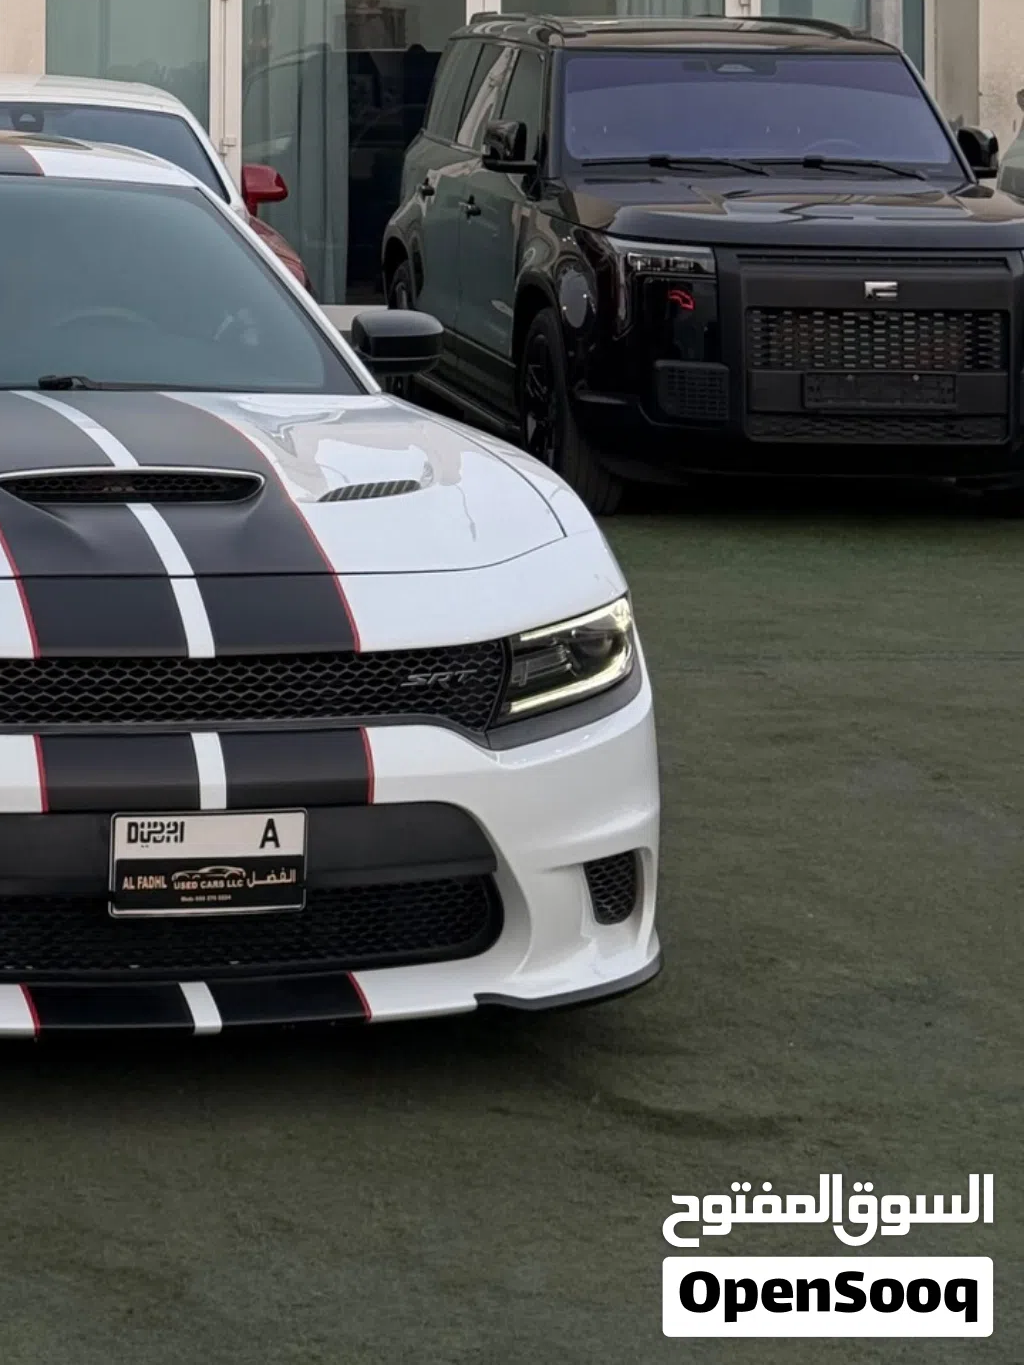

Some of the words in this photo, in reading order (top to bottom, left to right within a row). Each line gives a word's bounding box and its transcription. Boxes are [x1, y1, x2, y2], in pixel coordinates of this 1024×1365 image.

[400, 668, 478, 690] SRT
[259, 818, 281, 849] A
[122, 876, 135, 890] AL
[137, 875, 168, 890] FADHL
[173, 881, 199, 890] USED
[200, 880, 225, 889] CARS
[226, 878, 244, 888] LLC
[246, 866, 297, 888] الفضل
